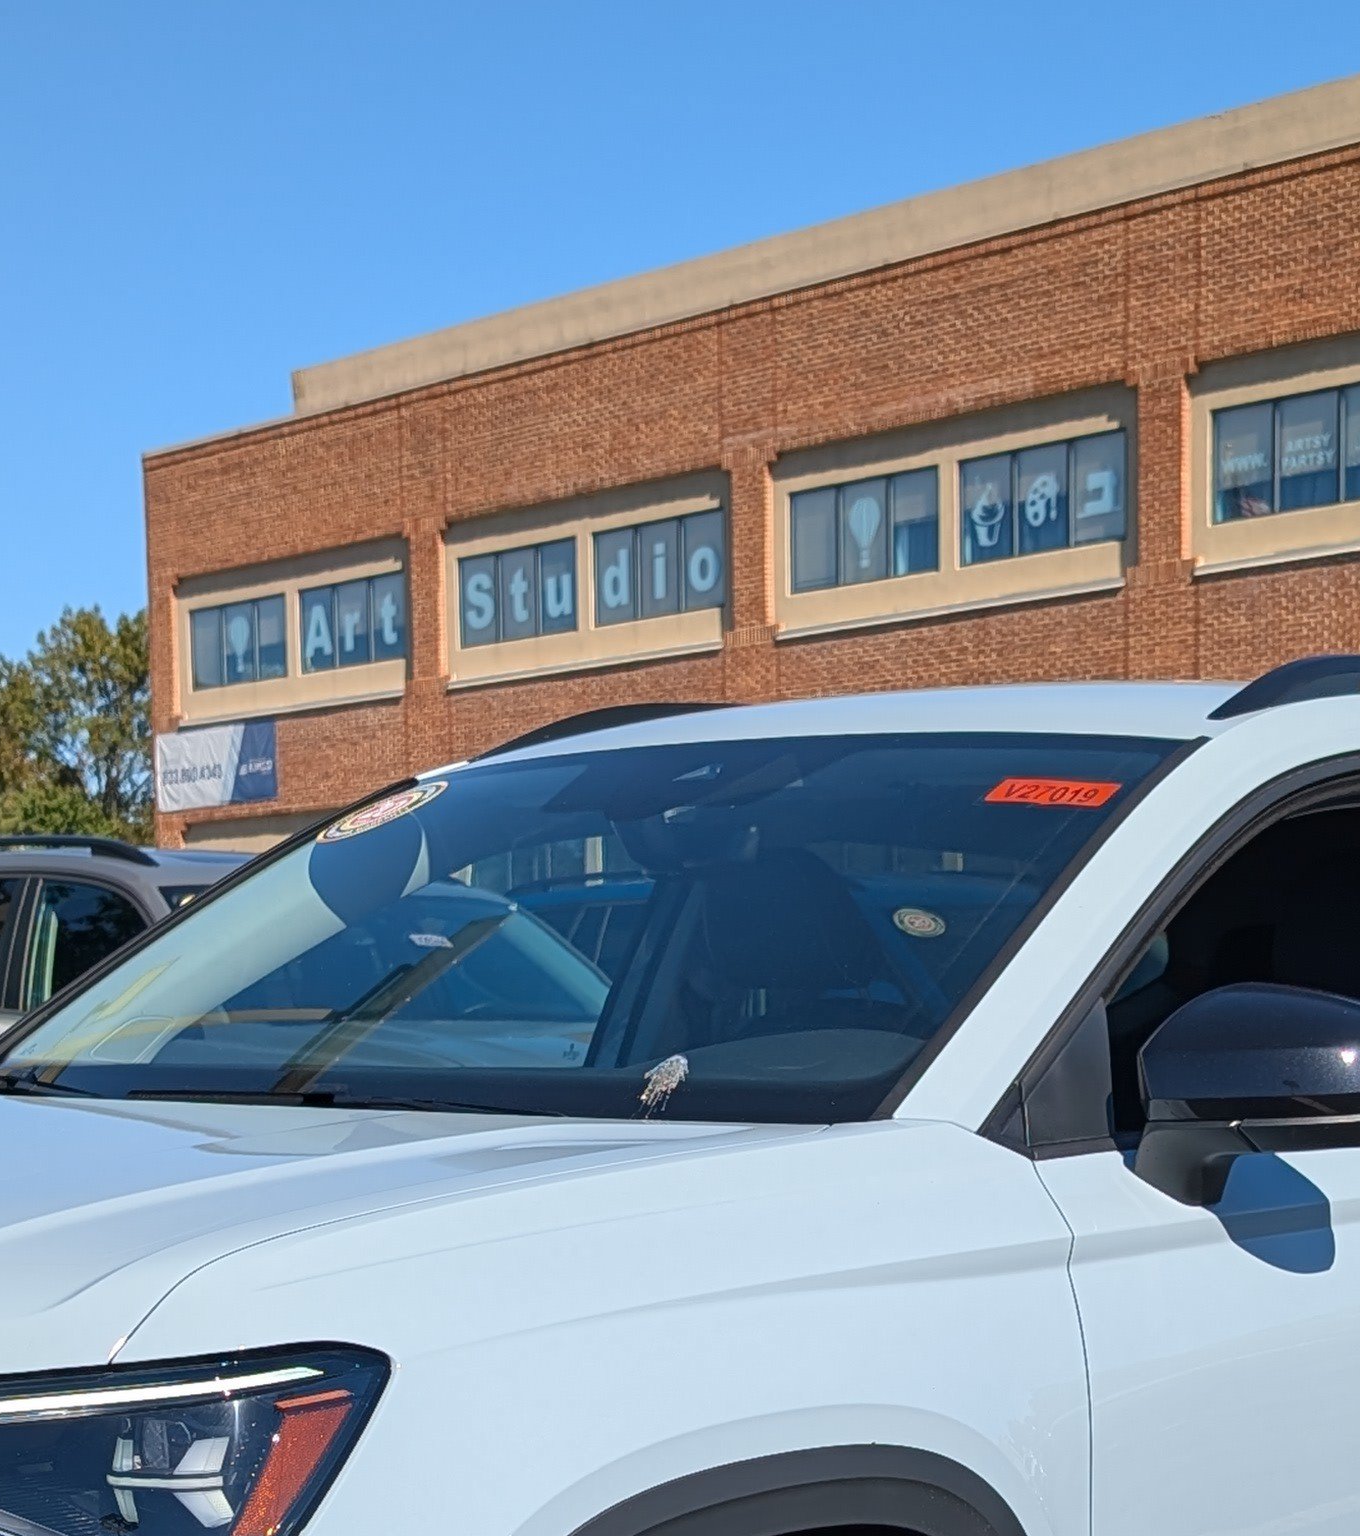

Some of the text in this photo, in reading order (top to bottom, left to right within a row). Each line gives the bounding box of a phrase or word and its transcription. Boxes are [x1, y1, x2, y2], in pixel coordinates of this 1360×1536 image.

[303, 542, 720, 658] Art Studio
[1004, 783, 1101, 803] V27019
